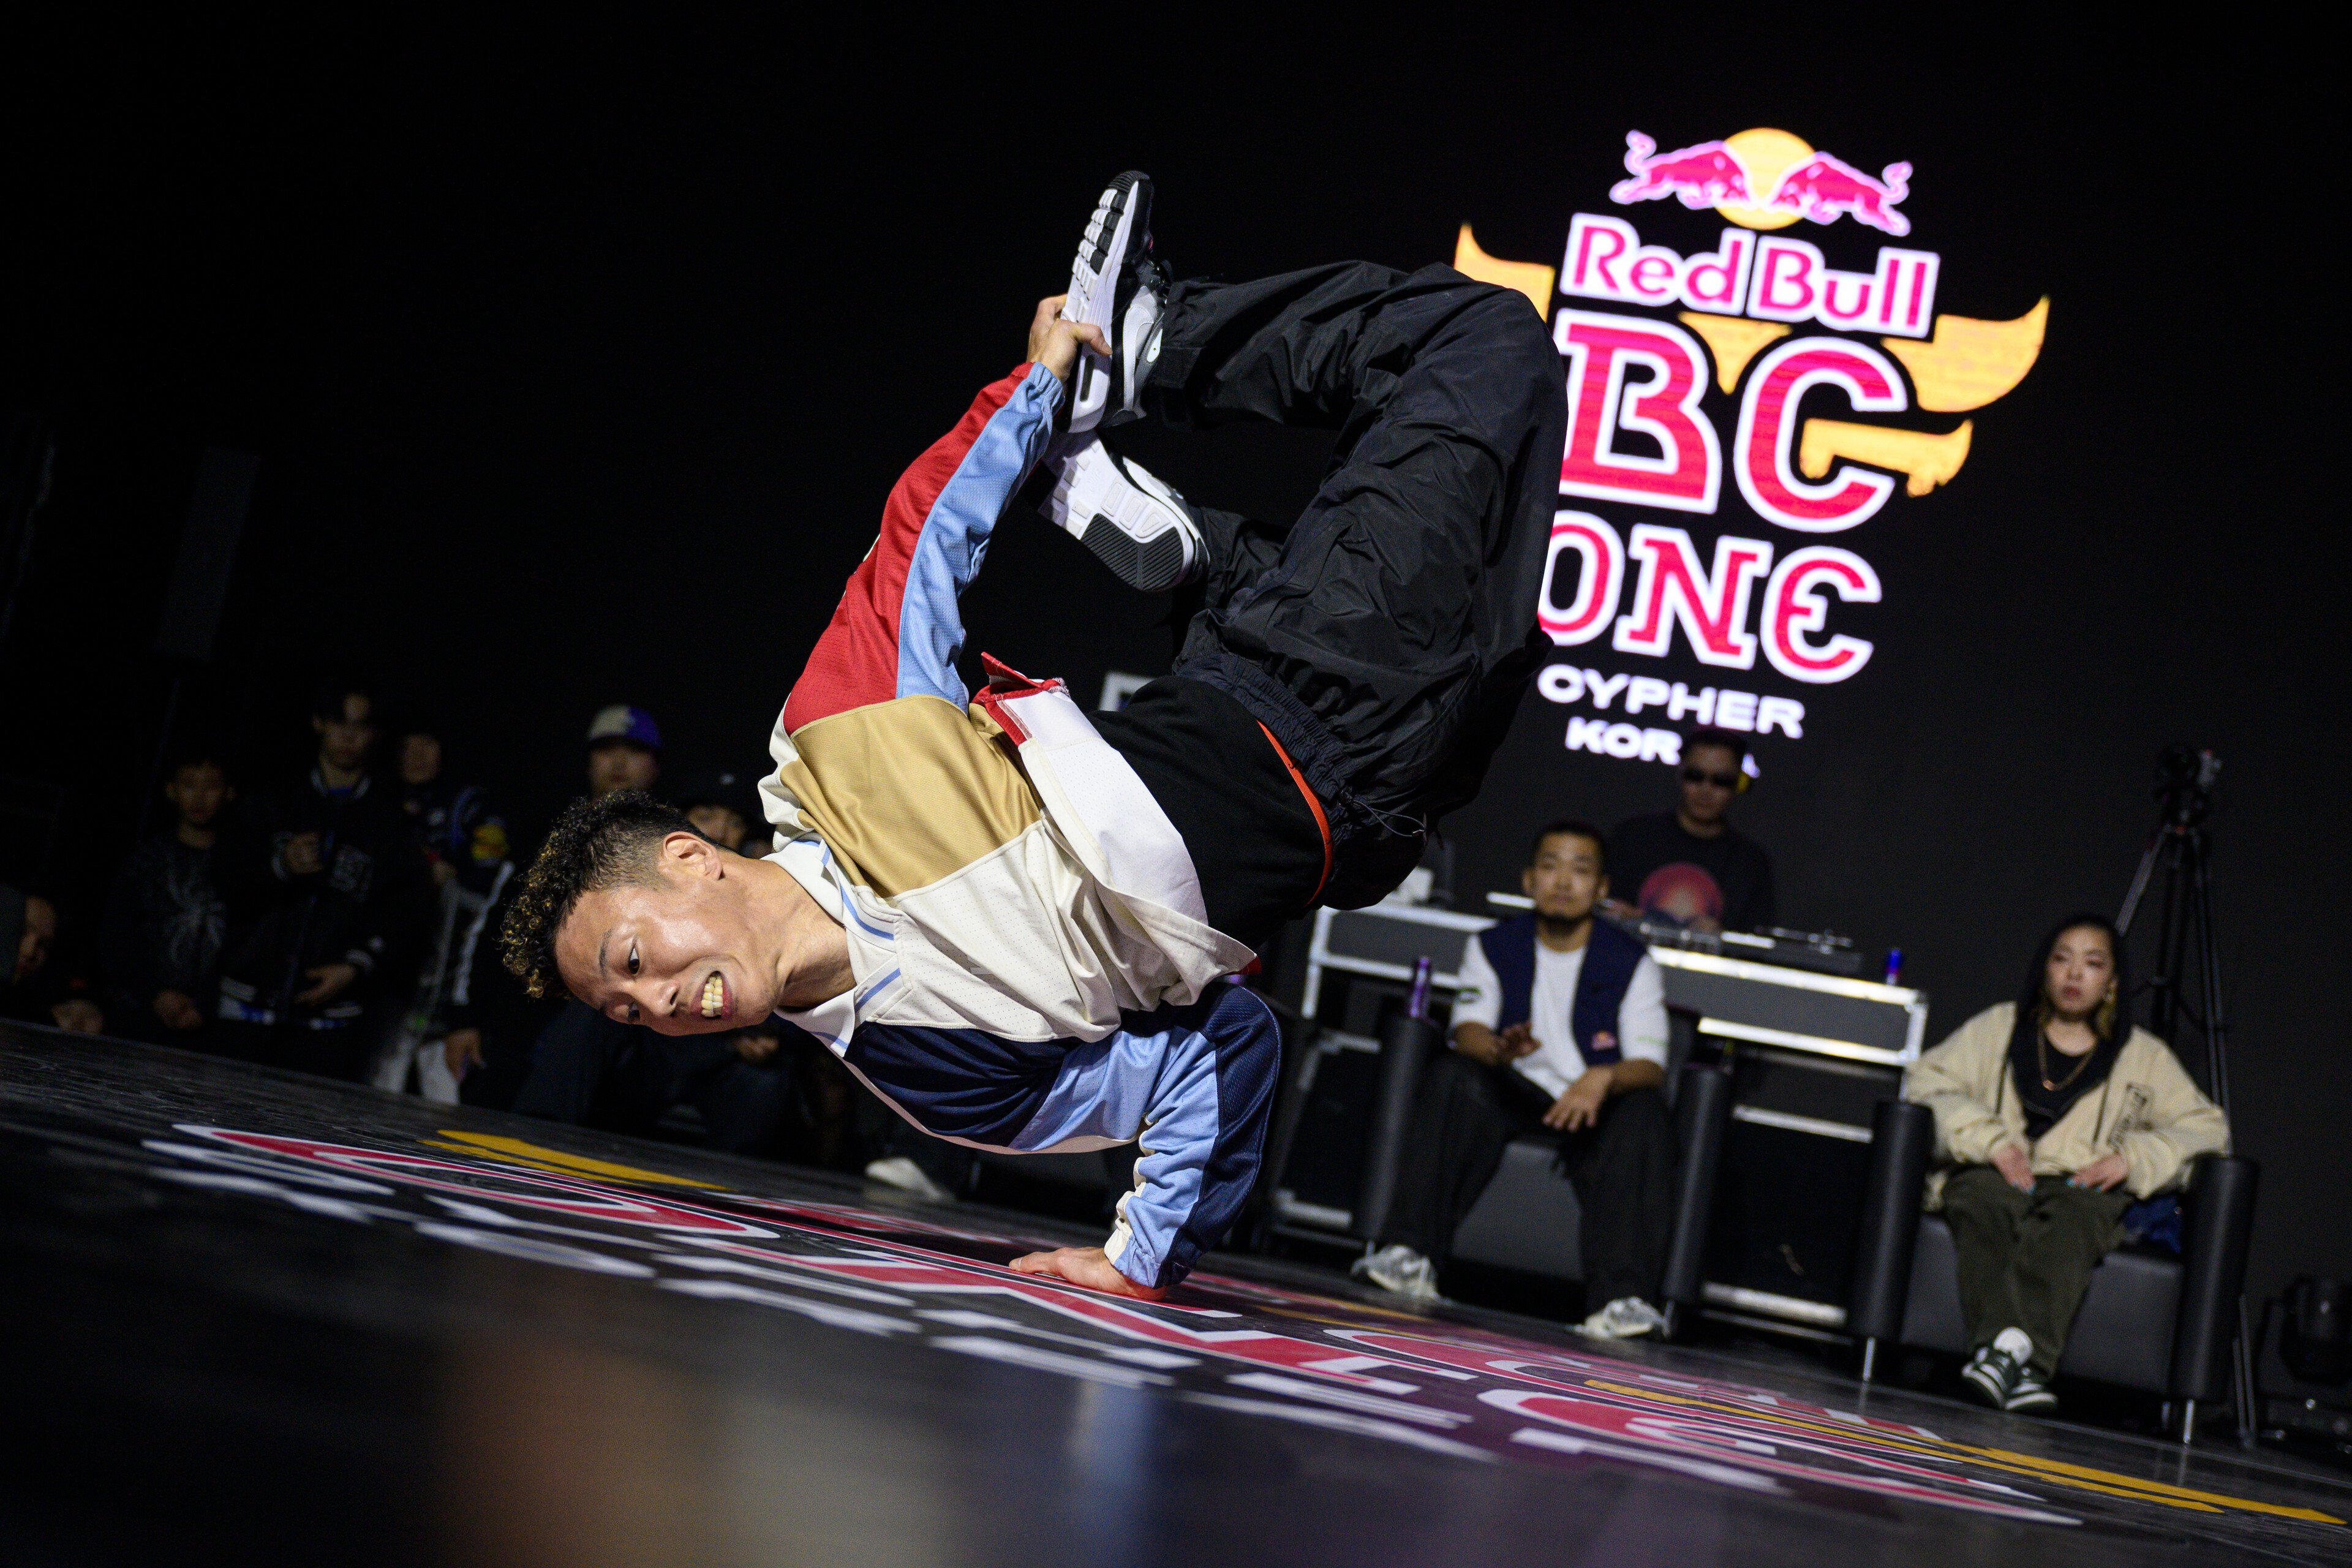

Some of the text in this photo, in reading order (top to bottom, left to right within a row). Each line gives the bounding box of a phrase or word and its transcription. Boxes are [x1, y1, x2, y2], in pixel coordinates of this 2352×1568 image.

[1559, 212, 1940, 338] Red Bull
[1554, 307, 1907, 532] BC
[1538, 510, 1882, 684] ONE
[1537, 664, 1805, 739] CYPHER
